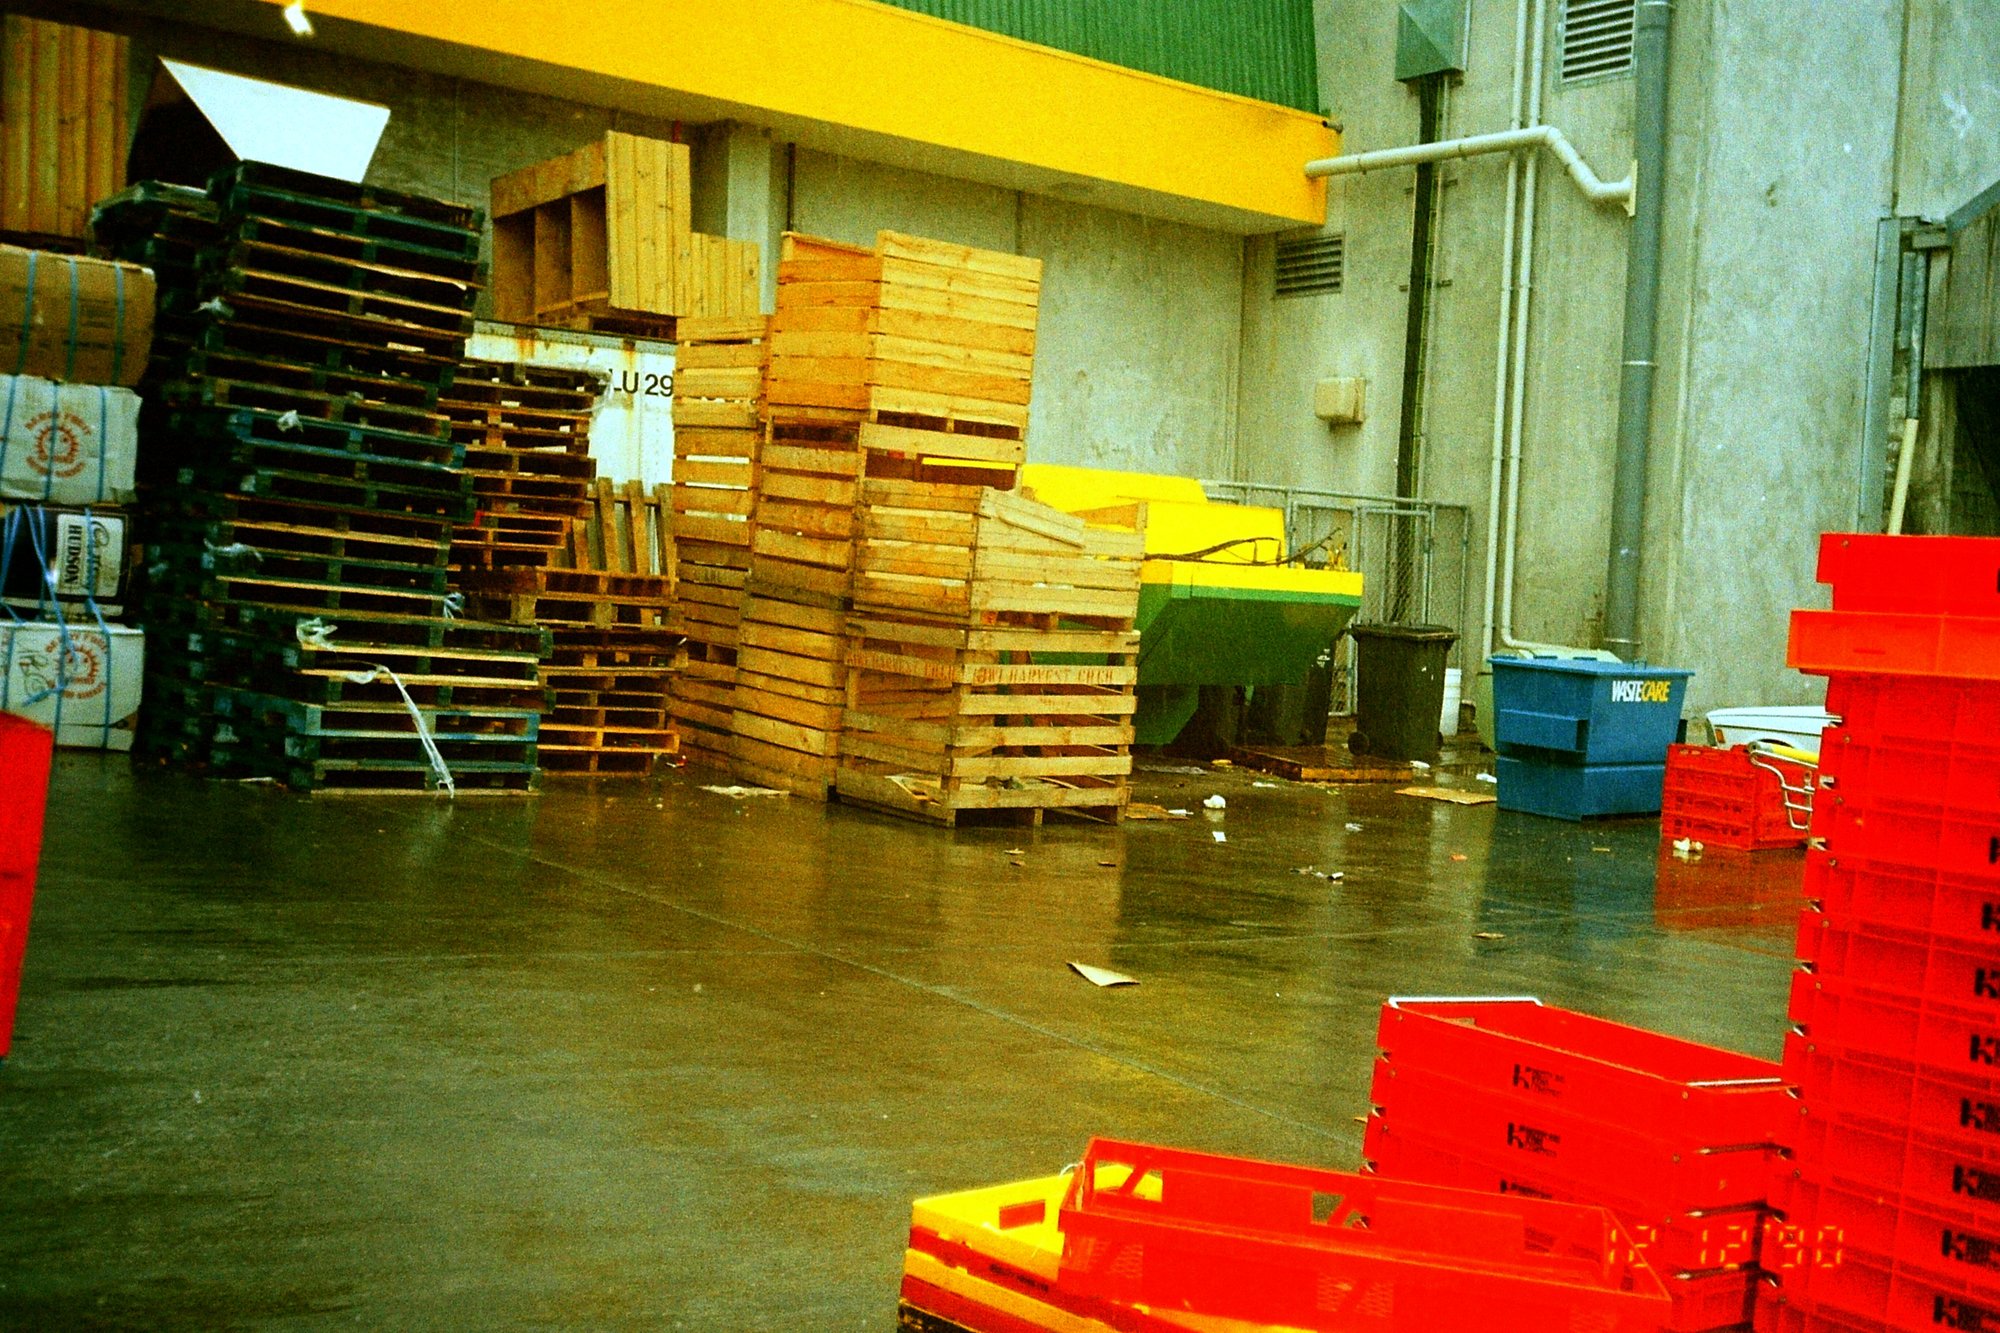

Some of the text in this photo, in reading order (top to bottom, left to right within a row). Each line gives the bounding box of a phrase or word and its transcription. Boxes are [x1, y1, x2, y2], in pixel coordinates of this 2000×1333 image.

[645, 374, 673, 397] 29
[64, 524, 82, 585] HUDSON
[1611, 679, 1671, 703] WASTECARE
